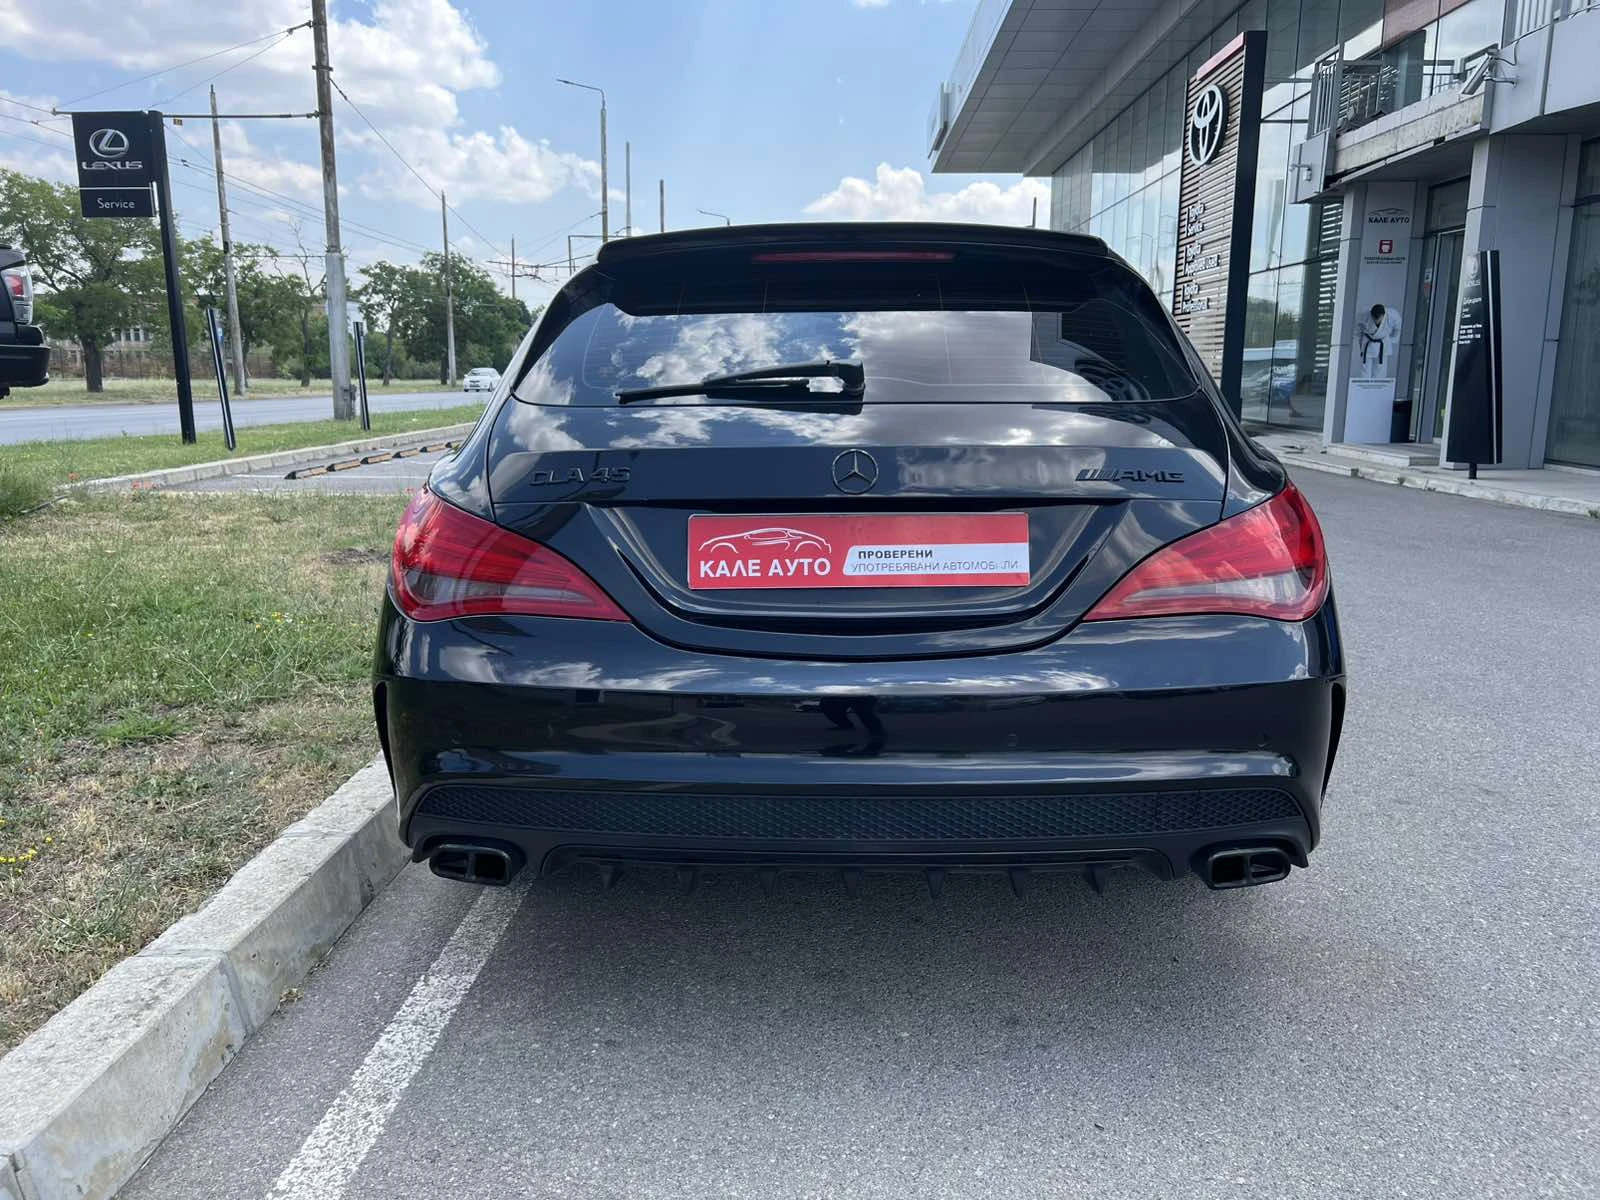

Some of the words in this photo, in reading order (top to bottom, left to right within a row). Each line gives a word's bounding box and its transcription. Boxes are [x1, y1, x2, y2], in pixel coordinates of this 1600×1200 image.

[82, 161, 143, 170] LEXUS
[97, 197, 135, 208] Service
[1188, 201, 1205, 219] Toyota
[1390, 216, 1410, 224] АУТО
[1187, 221, 1204, 236] Service
[1186, 241, 1202, 259] Toyota
[1184, 280, 1199, 300] Toyota
[858, 549, 933, 560] ПРОВЕРЕНИ
[700, 559, 762, 578] КАЛЕ
[768, 557, 832, 577] АУТО
[852, 561, 940, 573] УПОТРЕБЯВАНИ
